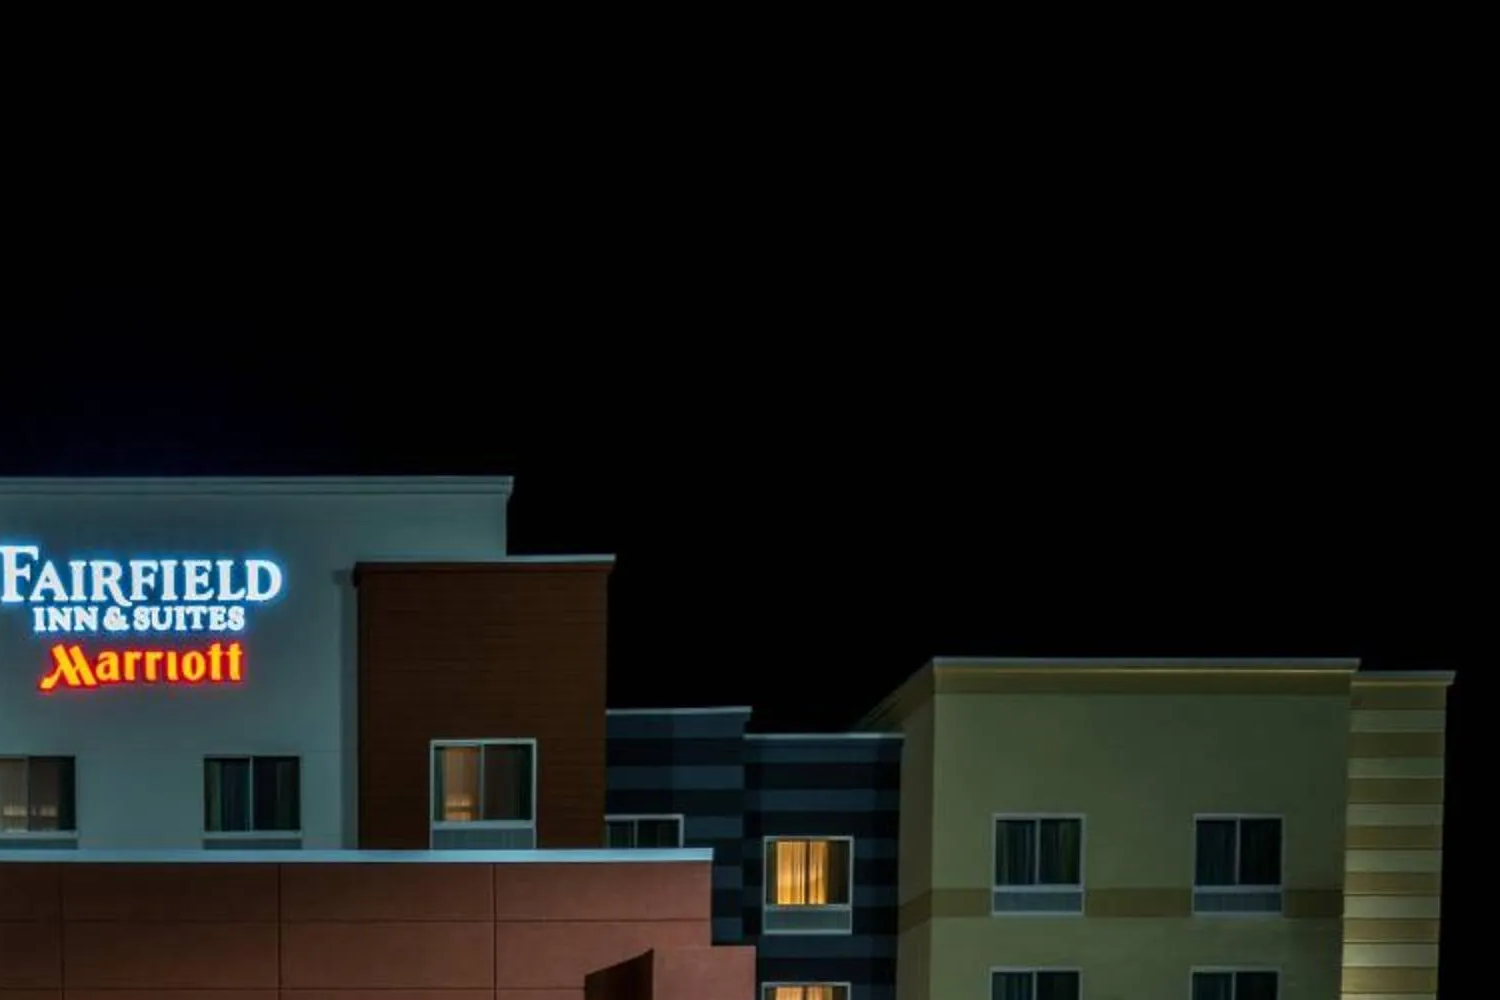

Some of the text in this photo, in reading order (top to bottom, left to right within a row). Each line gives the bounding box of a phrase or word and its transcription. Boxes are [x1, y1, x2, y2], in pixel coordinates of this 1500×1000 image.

[33, 606, 246, 631] INN & SUITES
[39, 643, 243, 690] Marriott
